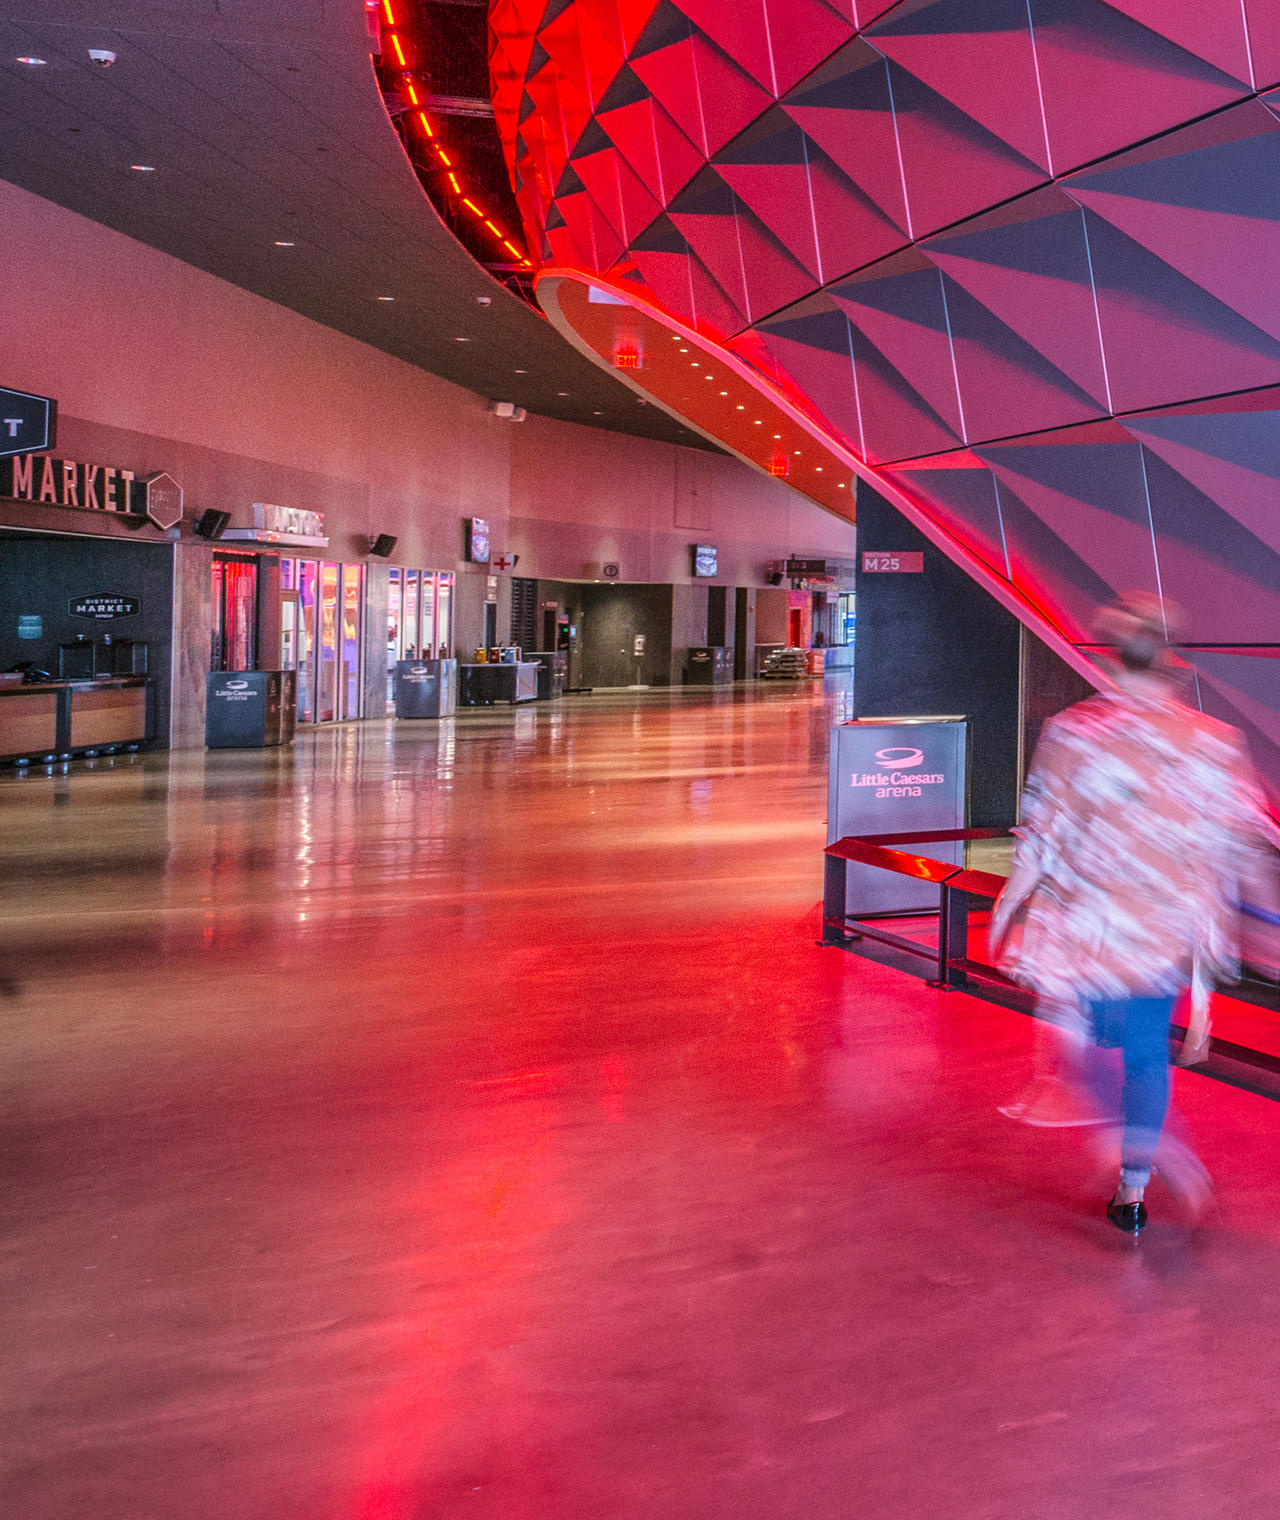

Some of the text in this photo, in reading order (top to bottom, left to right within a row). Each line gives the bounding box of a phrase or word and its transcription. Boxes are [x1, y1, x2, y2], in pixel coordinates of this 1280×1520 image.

[12, 453, 135, 513] MARKET
[864, 558, 900, 571] M 25
[76, 604, 133, 613] MARKET
[850, 771, 945, 787] Little Caesars
[875, 786, 922, 799] arena
